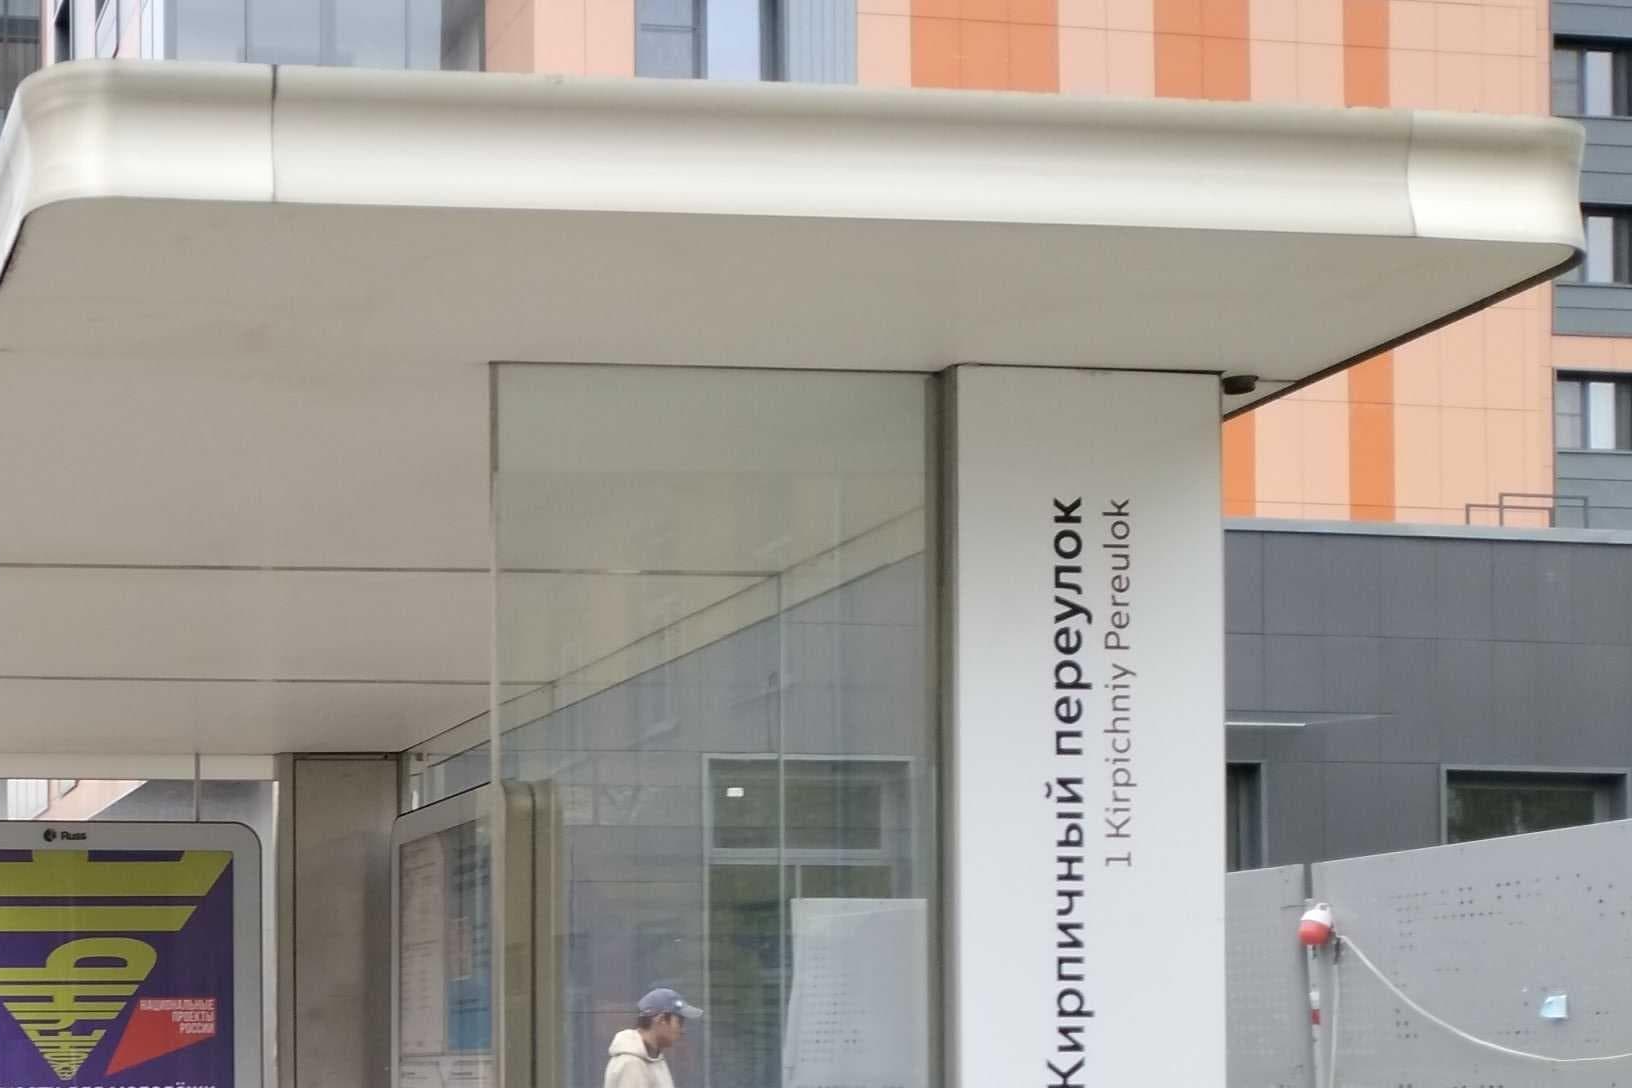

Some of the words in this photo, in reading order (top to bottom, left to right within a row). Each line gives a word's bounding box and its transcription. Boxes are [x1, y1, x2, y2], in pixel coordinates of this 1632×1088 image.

[1101, 498, 1132, 651] Pereulok
[1052, 496, 1093, 757] переулок
[1103, 662, 1138, 840] Kirpichniy
[1105, 850, 1133, 868] 1
[172, 1011, 215, 1022] ПРОЕКТЫ
[180, 1023, 215, 1034] РОССИИ
